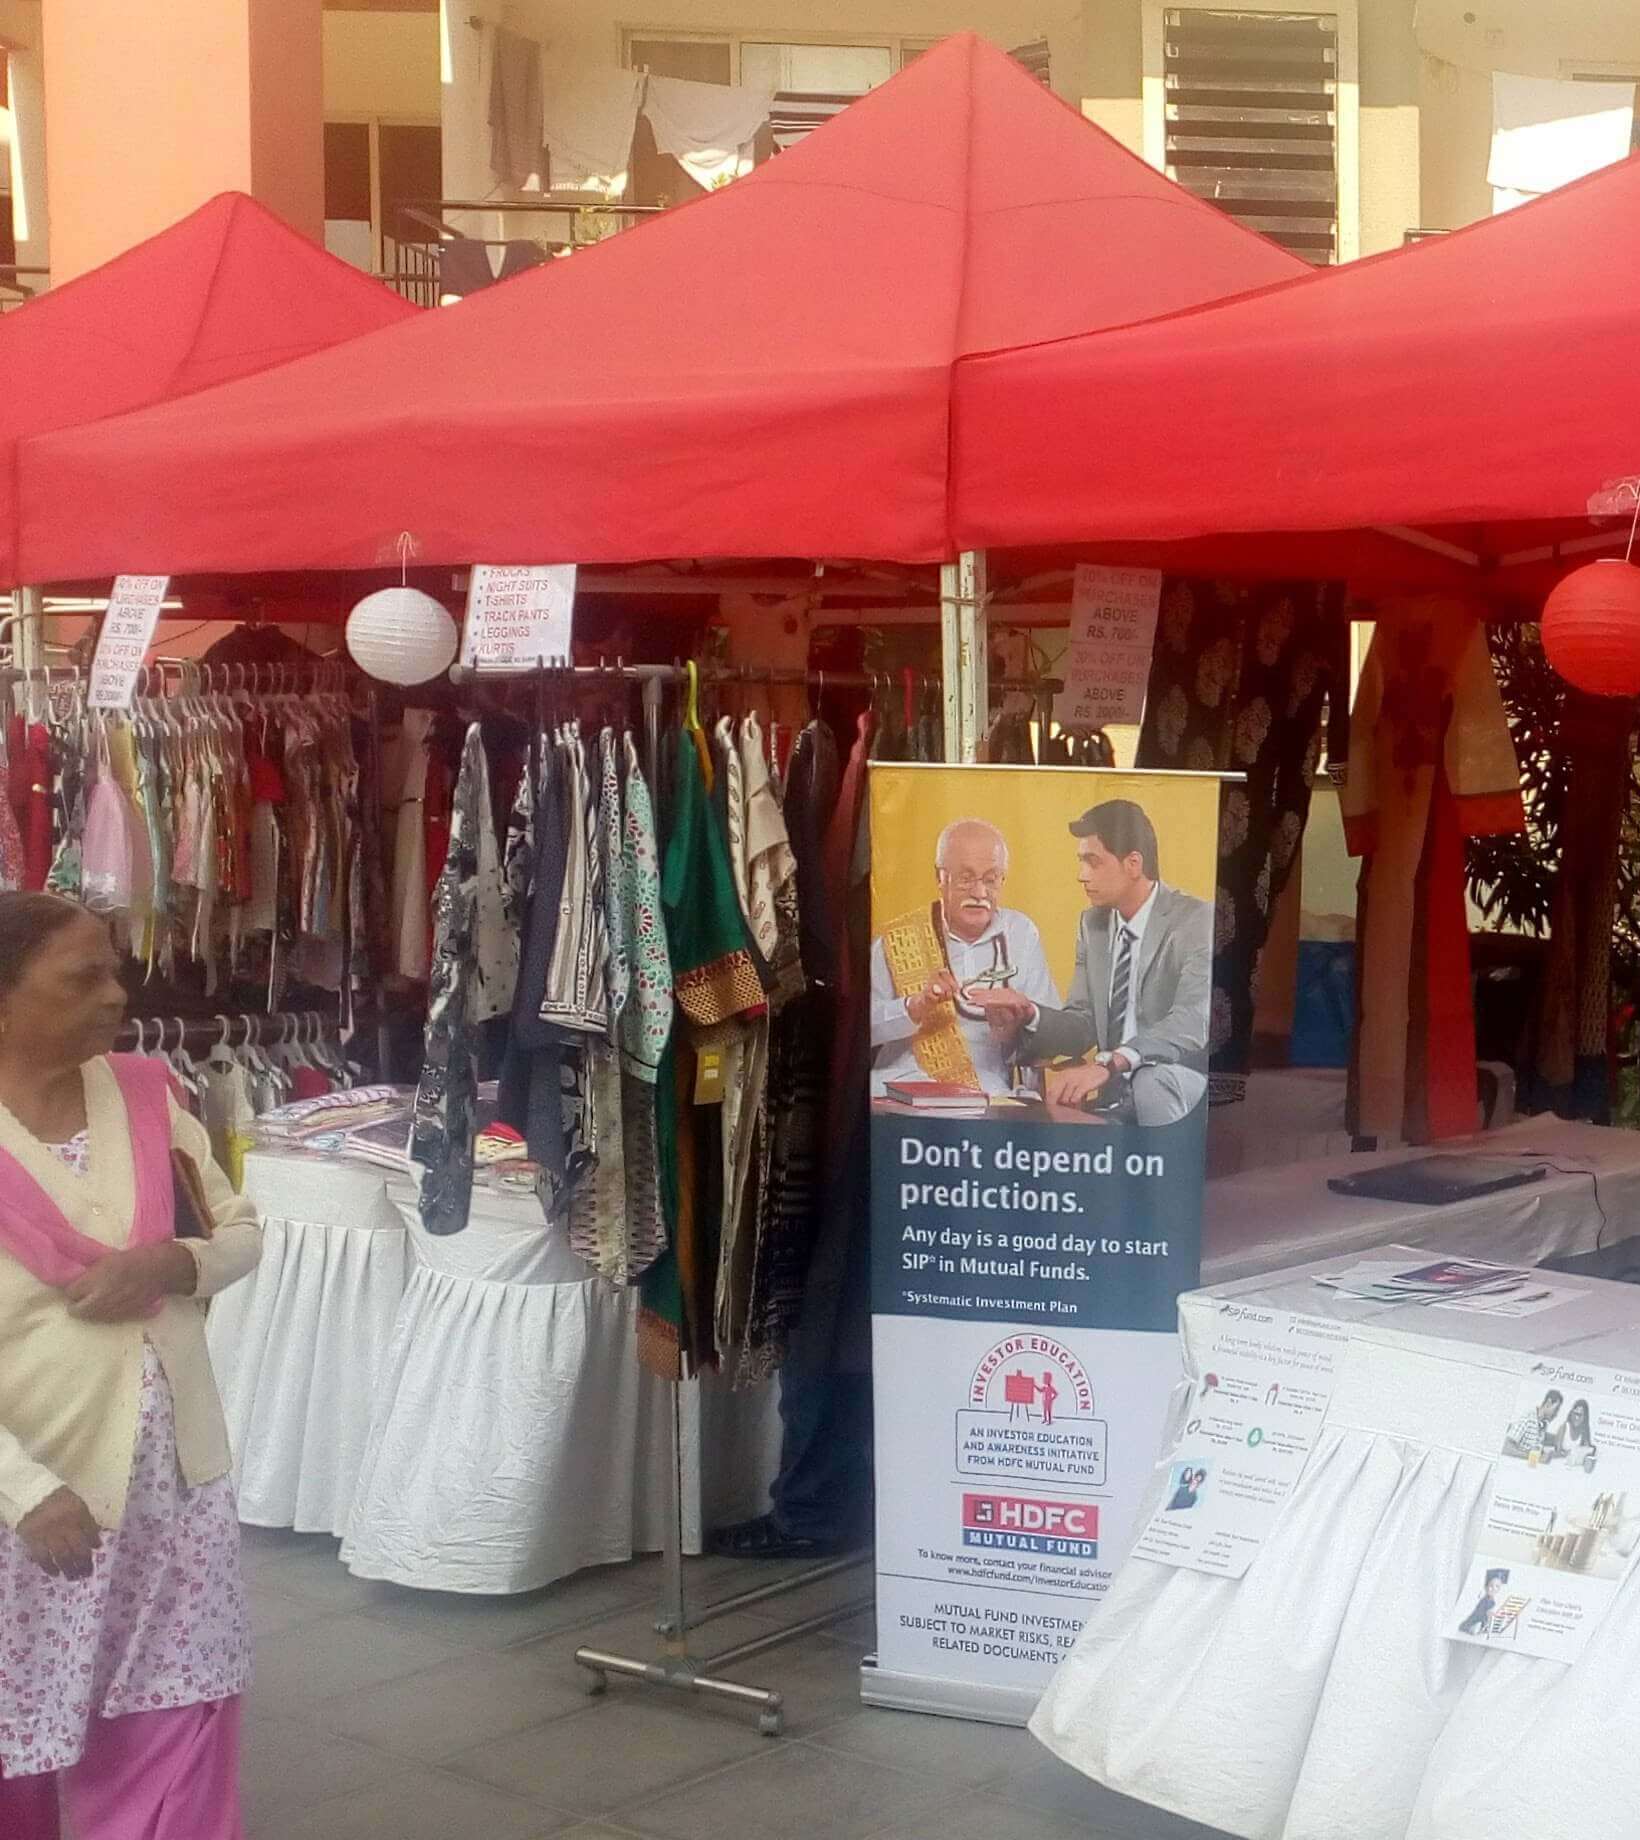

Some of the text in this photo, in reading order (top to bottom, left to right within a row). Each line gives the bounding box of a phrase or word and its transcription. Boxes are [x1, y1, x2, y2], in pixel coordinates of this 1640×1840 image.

[519, 579, 548, 591] SUITS
[518, 608, 550, 621] PANTS
[1093, 607, 1137, 623] ABOVE
[480, 626, 530, 639] LEGGINGS
[1084, 687, 1127, 702] ABOVE
[993, 1141, 1113, 1178] depend
[1125, 1153, 1165, 1177] on
[900, 1179, 1085, 1215] predictions.
[902, 1225, 1169, 1257] Any day is a good day to start
[939, 1256, 955, 1273] in
[960, 1256, 1025, 1278] Mutual
[1029, 1260, 1091, 1282] Funds.
[976, 1295, 1046, 1312] Investment
[1049, 1301, 1078, 1314] Plan
[973, 1338, 1091, 1410] INVESTOR EDUCATION
[969, 1427, 1093, 1447] AN INVESTOR EDUCATION
[963, 1440, 1100, 1462] AND AWARENESS INITIATIVE
[967, 1454, 1095, 1475] FROM HDFC MUTUAL FUND
[999, 1499, 1087, 1535] HDFC
[967, 1531, 1093, 1557] MUTUAL FUND
[918, 1548, 929, 1559] To
[930, 1550, 953, 1562] know
[983, 1558, 1015, 1570] contact
[1017, 1561, 1037, 1572] your
[1039, 1562, 1078, 1577] financial
[948, 1565, 1110, 1592] www.hdfcfund.com/InvestorEducatio
[934, 1603, 982, 1620] MUTUAL
[984, 1608, 1018, 1625] FUND
[900, 1614, 947, 1632] SUBJECT
[951, 1621, 967, 1634] TO
[969, 1624, 1015, 1642] MARKET
[1018, 1630, 1053, 1648] RISKS,
[932, 1636, 1059, 1665] RELATED DOCUMENTS
